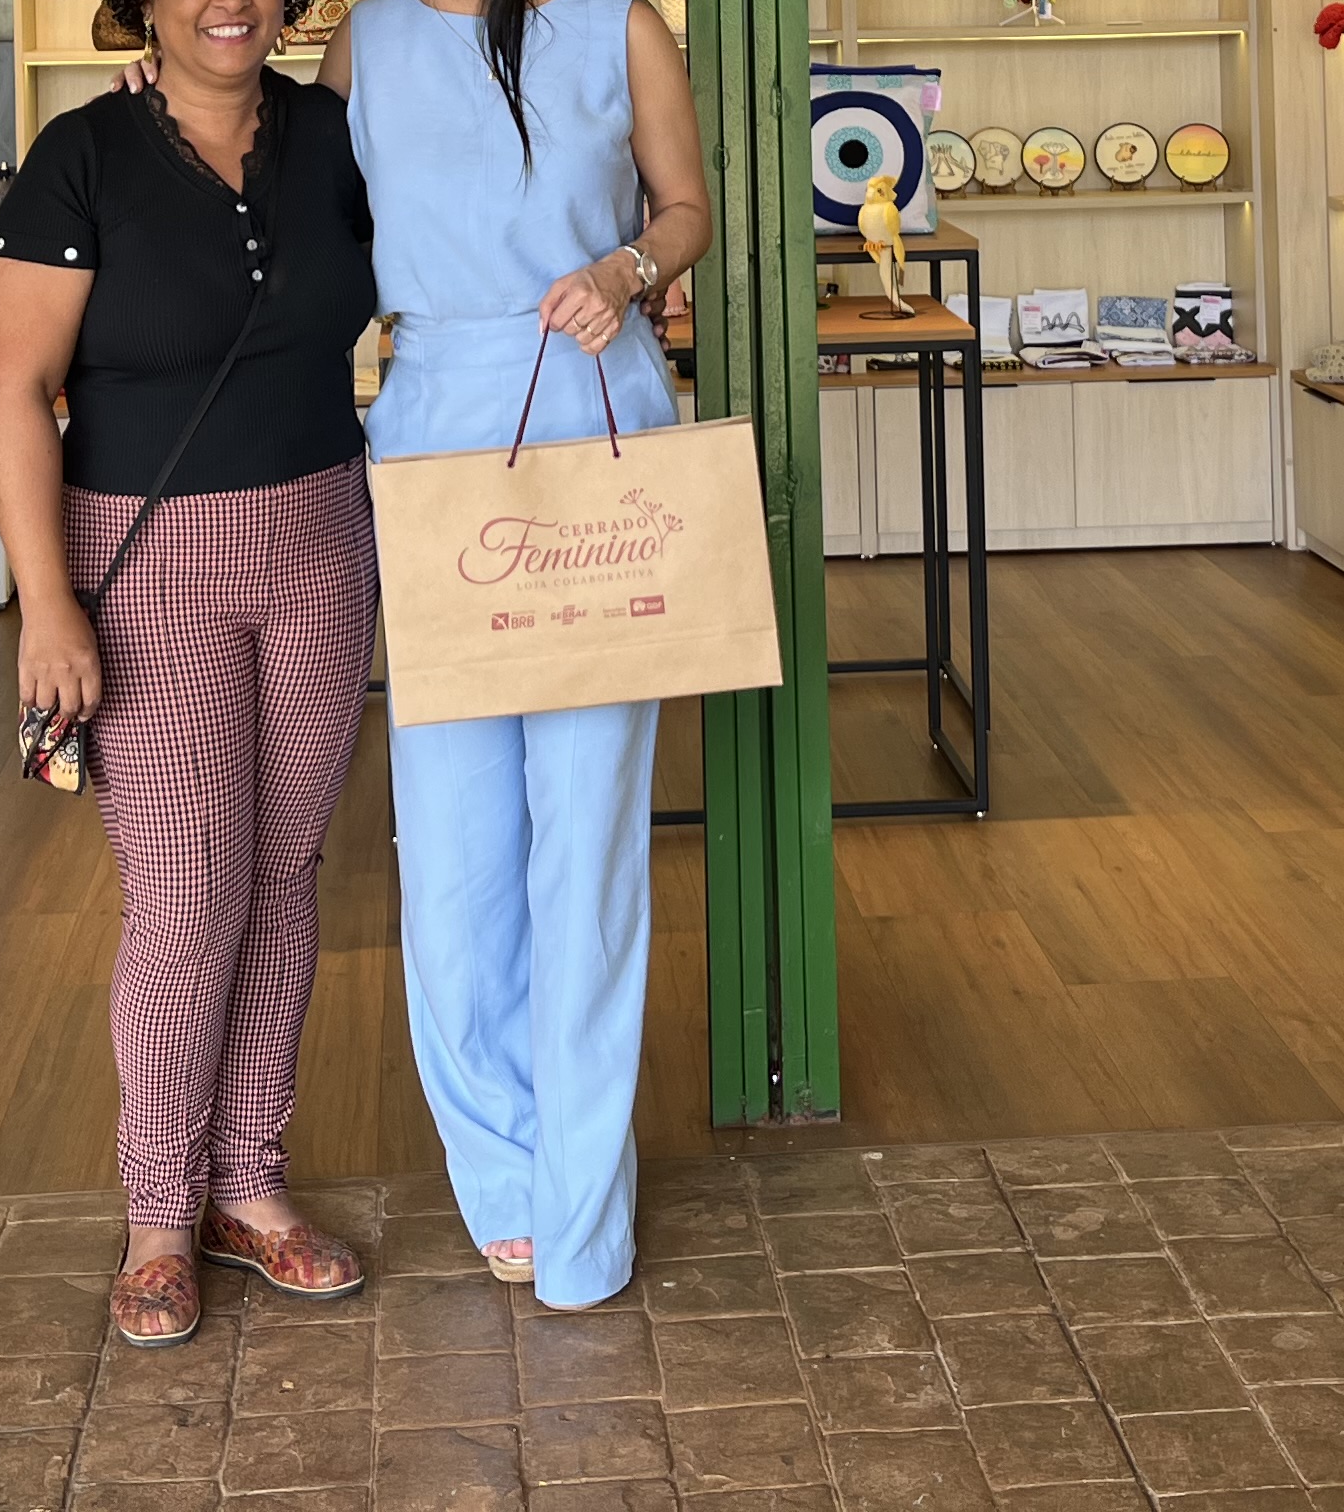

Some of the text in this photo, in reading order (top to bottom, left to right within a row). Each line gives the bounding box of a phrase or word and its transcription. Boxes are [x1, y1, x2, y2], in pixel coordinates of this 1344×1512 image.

[558, 516, 649, 538] CERRADO
[457, 516, 661, 585] Feminino
[516, 568, 654, 591] LOJA COLABORATIVA
[511, 615, 535, 629] BRB
